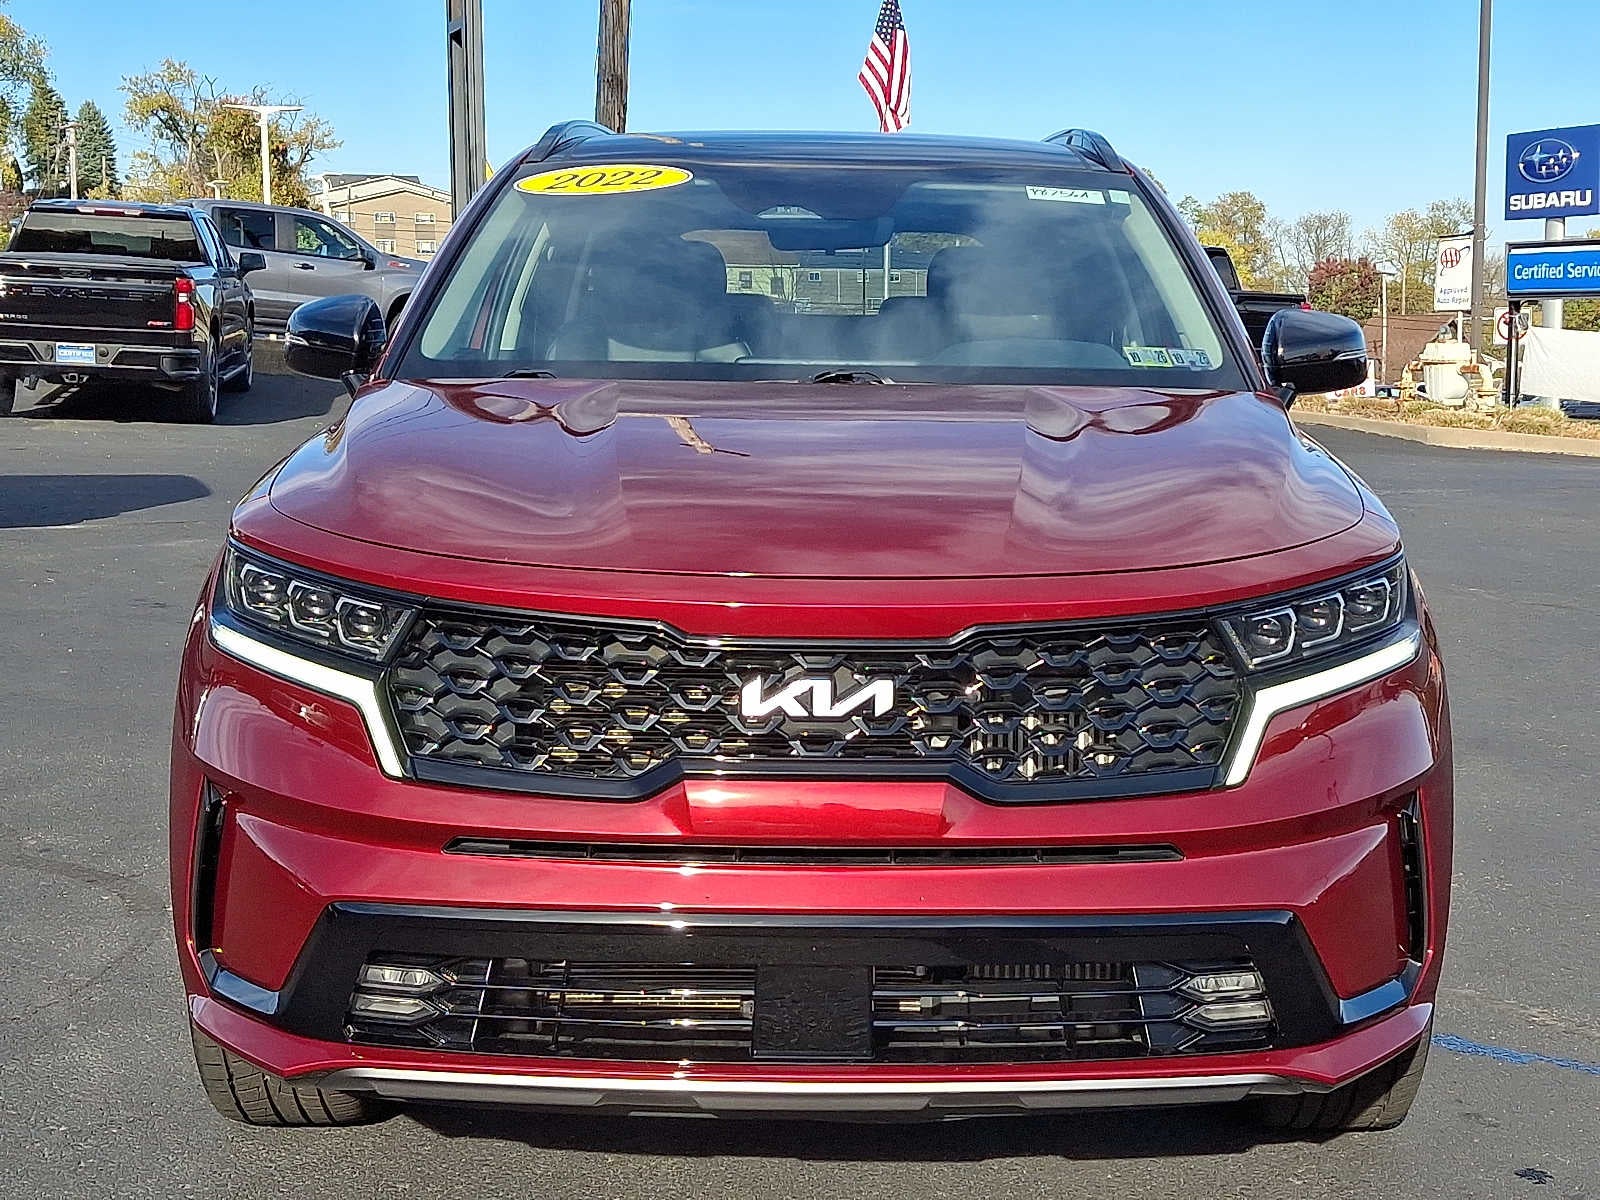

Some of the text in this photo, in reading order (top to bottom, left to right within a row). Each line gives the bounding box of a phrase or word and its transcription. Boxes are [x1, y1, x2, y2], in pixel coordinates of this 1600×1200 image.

[545, 170, 663, 190] 2022
[1509, 189, 1592, 211] SUBARU
[1514, 262, 1564, 279] Certified
